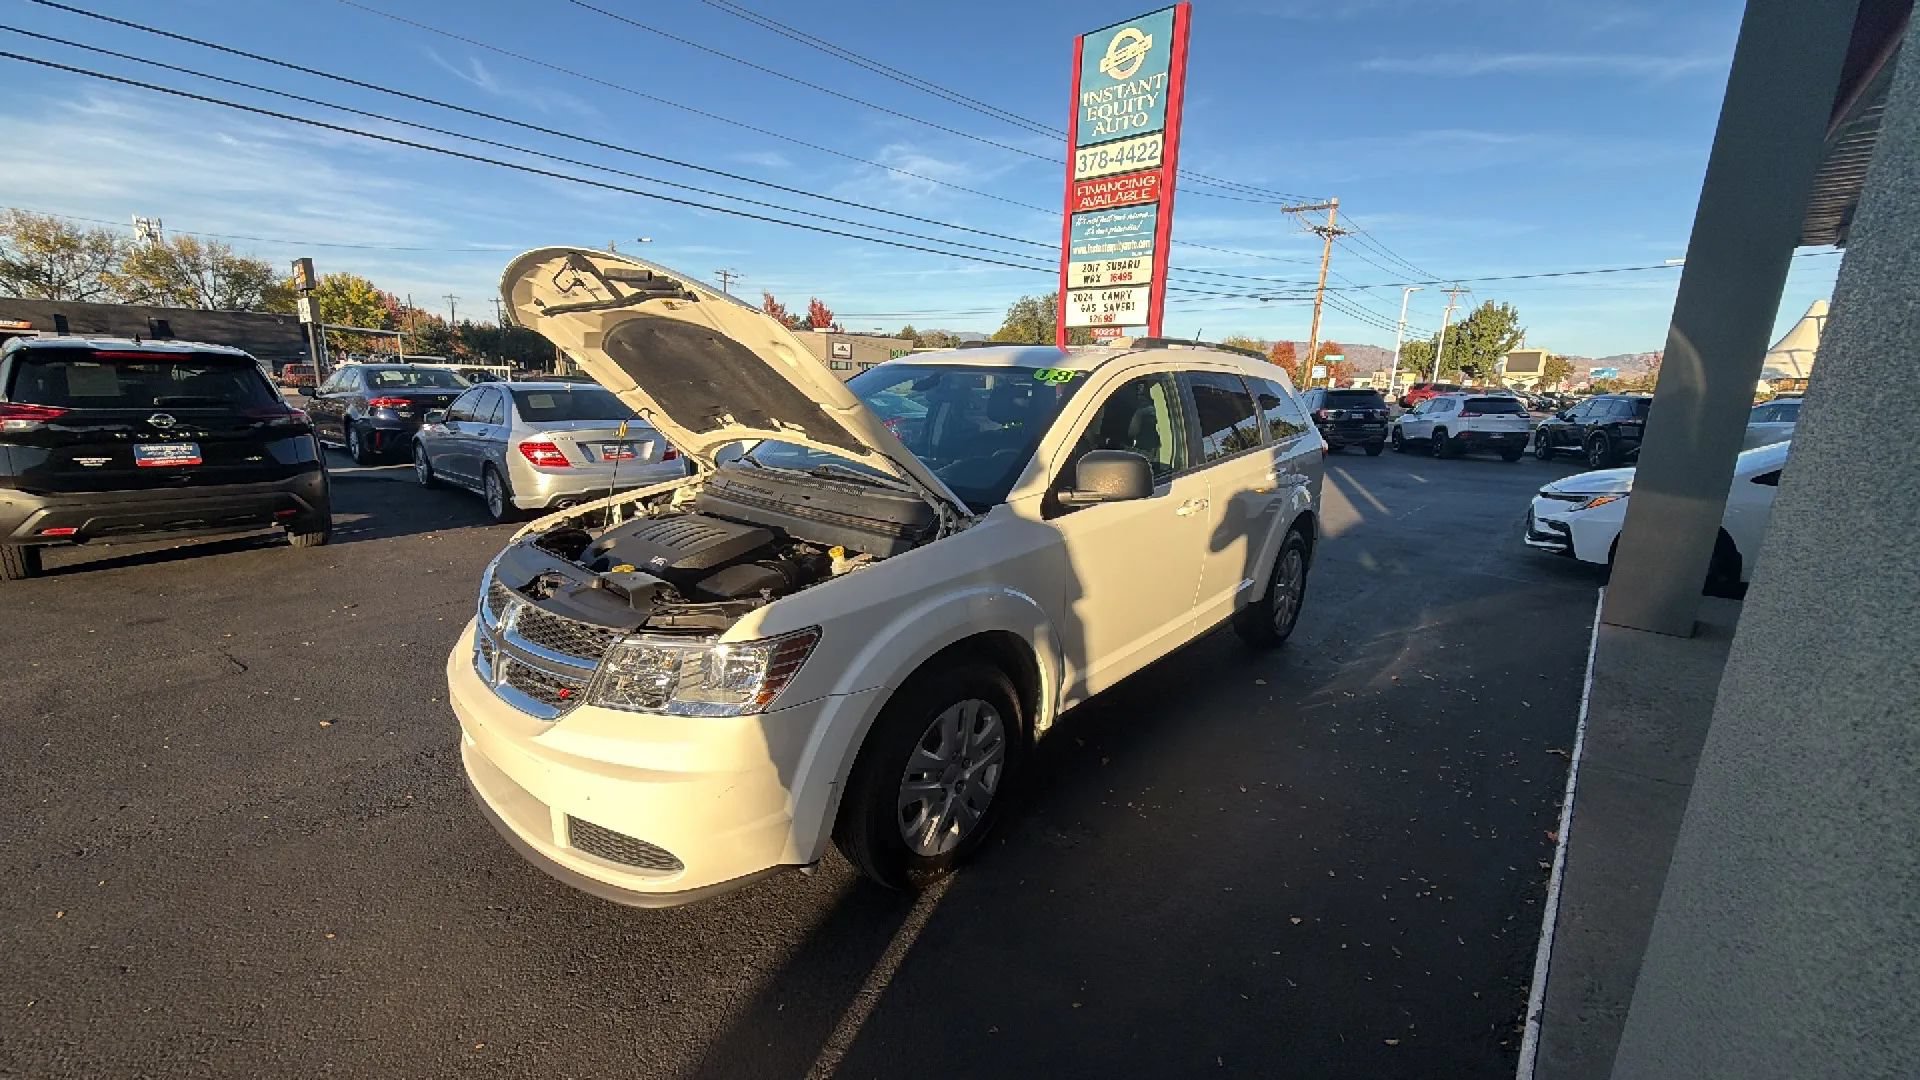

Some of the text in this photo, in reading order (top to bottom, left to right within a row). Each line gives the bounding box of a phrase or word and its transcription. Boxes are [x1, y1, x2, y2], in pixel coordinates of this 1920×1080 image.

[1083, 72, 1167, 107] INSTANT
[1087, 92, 1160, 122] EQUITY
[1091, 111, 1149, 137] AUTO
[1077, 139, 1159, 173] 378-4422
[1077, 175, 1156, 197] FINANCING
[1080, 187, 1152, 208] AVAILABLE
[1082, 259, 1141, 273] 2017 SUBARU
[1083, 273, 1102, 284] WRX
[1073, 289, 1133, 302] 2024 CAMRY
[1080, 303, 1097, 312] GAS
